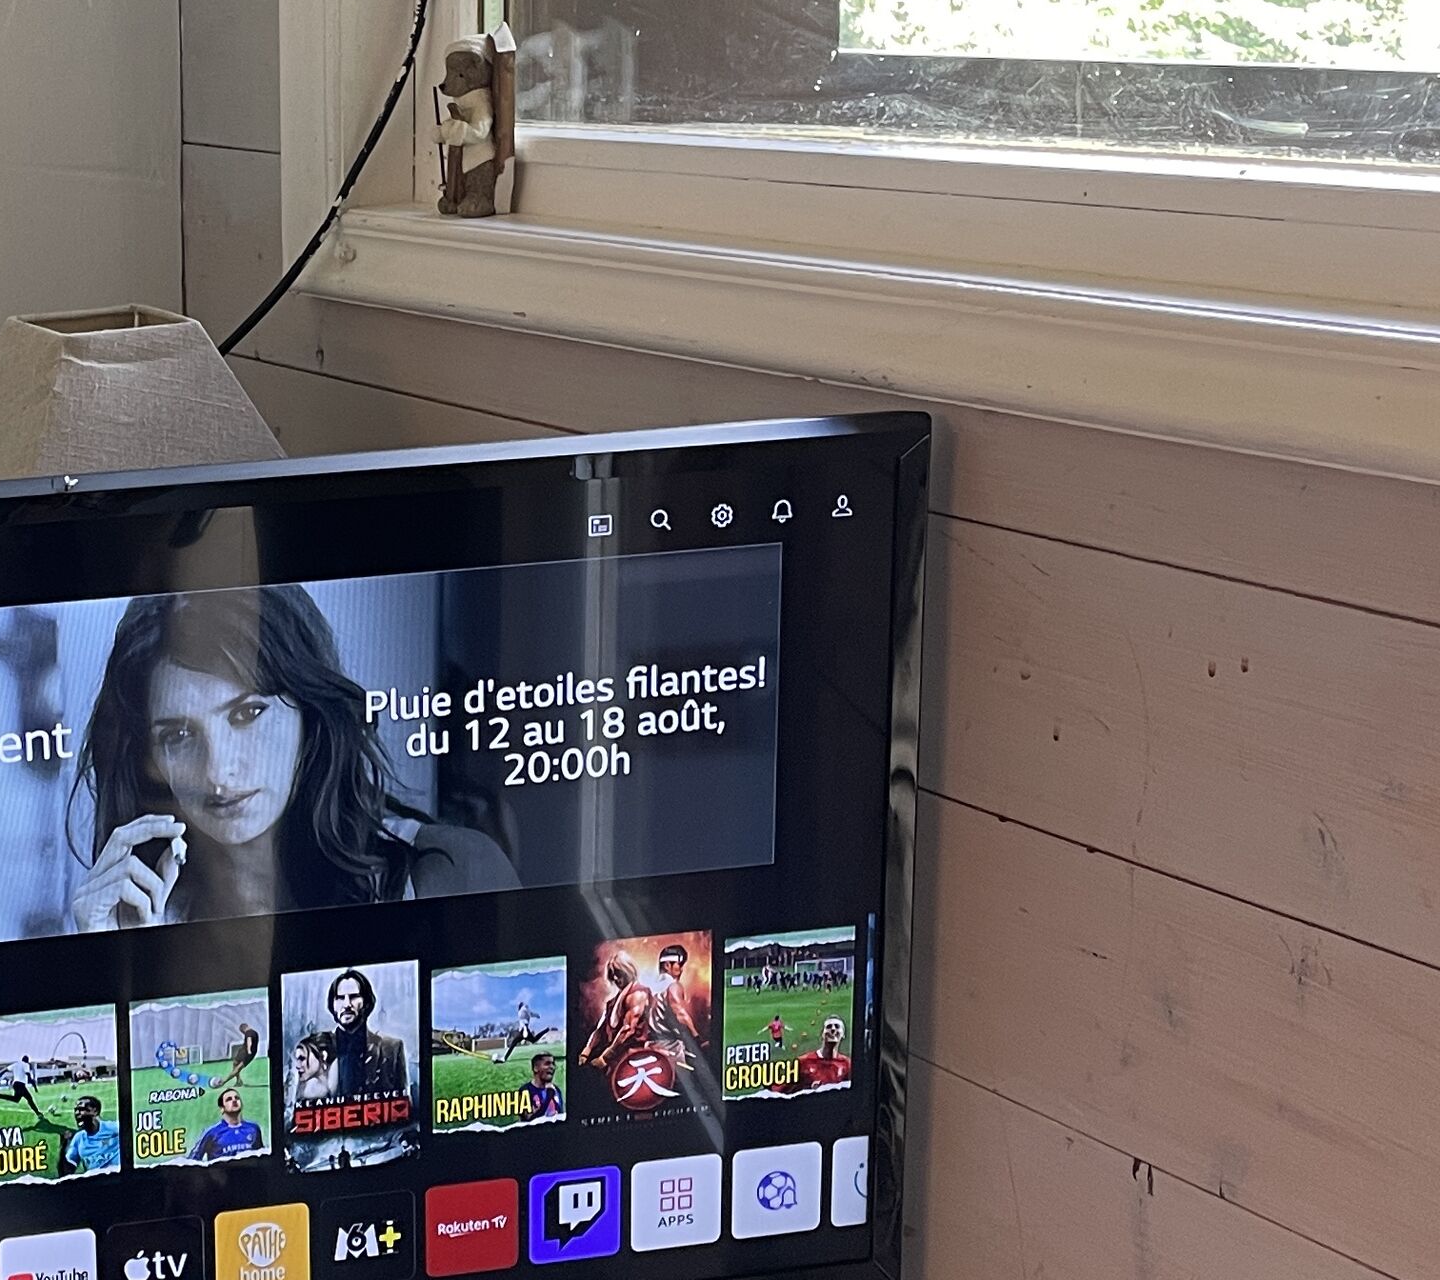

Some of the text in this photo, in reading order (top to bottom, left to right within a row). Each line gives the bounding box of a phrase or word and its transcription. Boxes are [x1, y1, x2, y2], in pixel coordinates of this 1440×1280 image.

[364, 656, 767, 724] Pluie d'etoiles filantes!
[405, 699, 726, 757] du 12 au 18 août,
[503, 745, 632, 787] 20:00h
[726, 1043, 769, 1065] PETER
[725, 1060, 800, 1091] CROUCH
[149, 1088, 197, 1103] RABONA
[435, 1089, 534, 1124] RAPHINHA
[136, 1111, 163, 1132] JOE
[136, 1128, 186, 1159] COLE
[658, 1213, 694, 1228] APPS
[152, 1251, 188, 1280] tv
